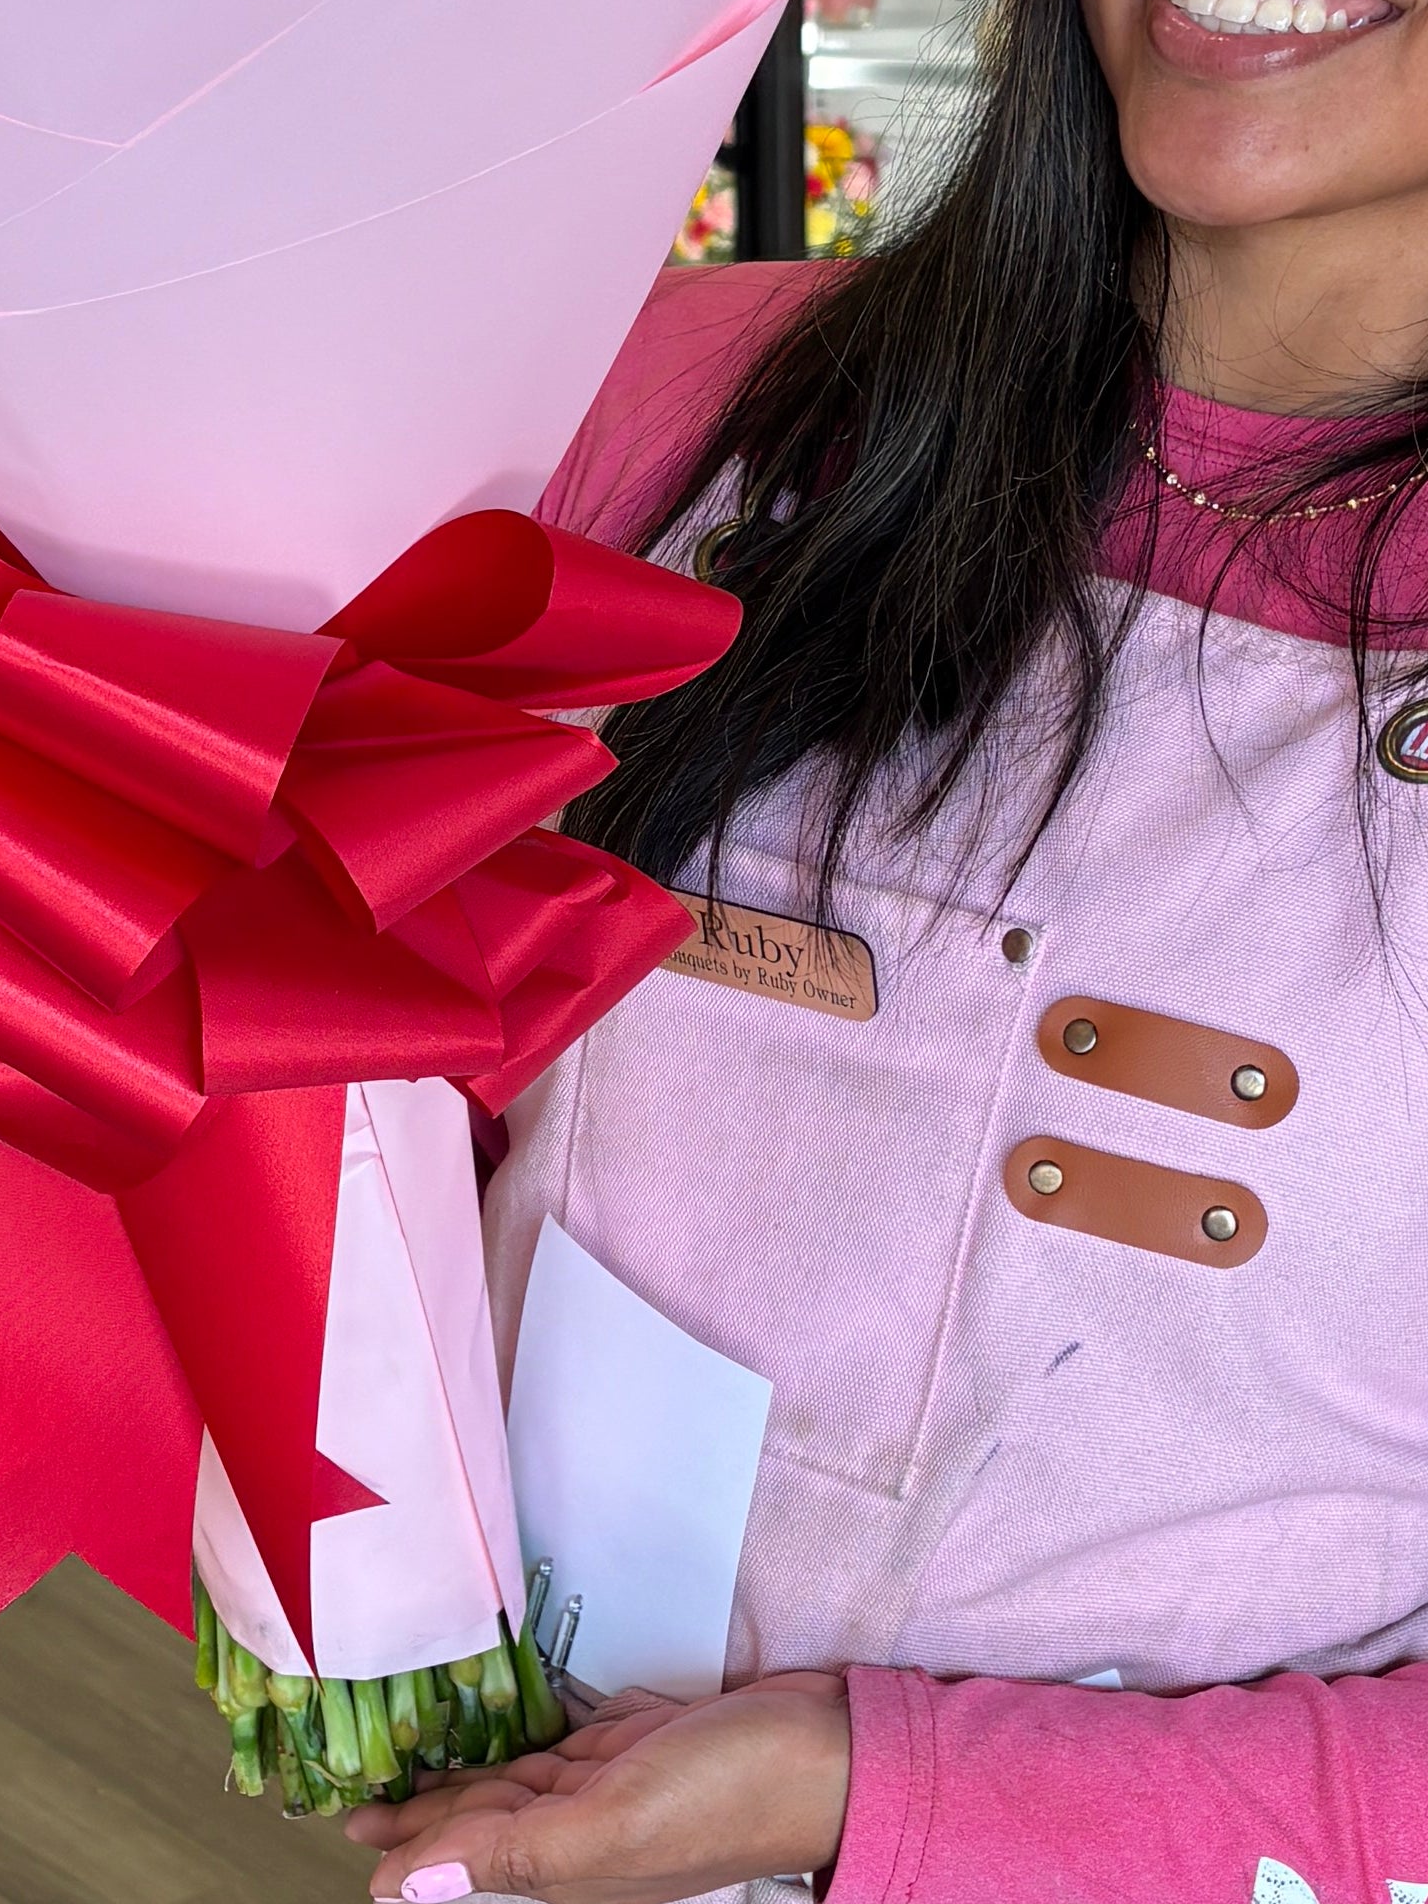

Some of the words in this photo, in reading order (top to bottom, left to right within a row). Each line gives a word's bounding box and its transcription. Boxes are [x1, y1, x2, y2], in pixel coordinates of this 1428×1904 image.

[695, 910, 805, 978] Ruby
[669, 948, 728, 977] ouquets
[733, 960, 751, 985] by
[757, 966, 797, 997] Ruby
[803, 979, 857, 1010] Owner
